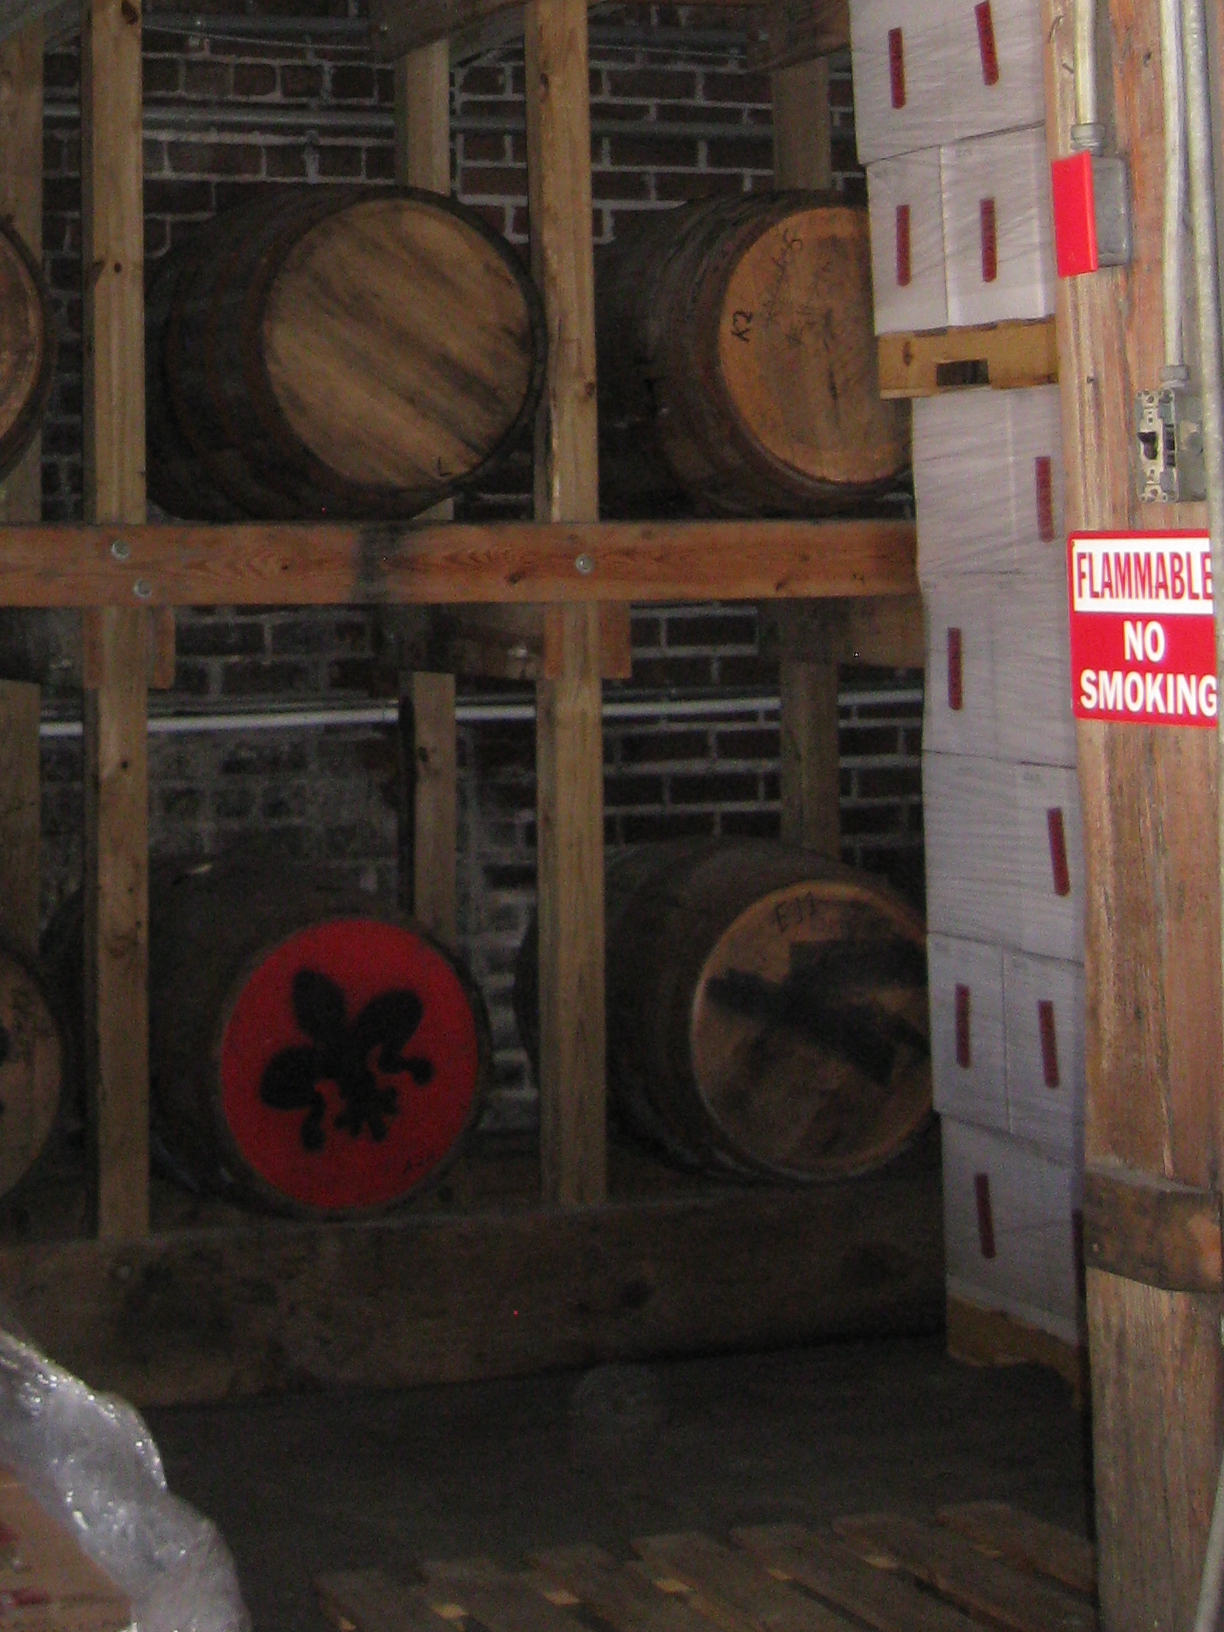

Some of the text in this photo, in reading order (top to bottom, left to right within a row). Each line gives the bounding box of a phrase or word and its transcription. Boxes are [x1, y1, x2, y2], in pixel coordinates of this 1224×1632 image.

[1076, 551, 1214, 601] FLAMMABLE
[1123, 619, 1166, 663] NO
[1080, 668, 1218, 717] SMOKING
